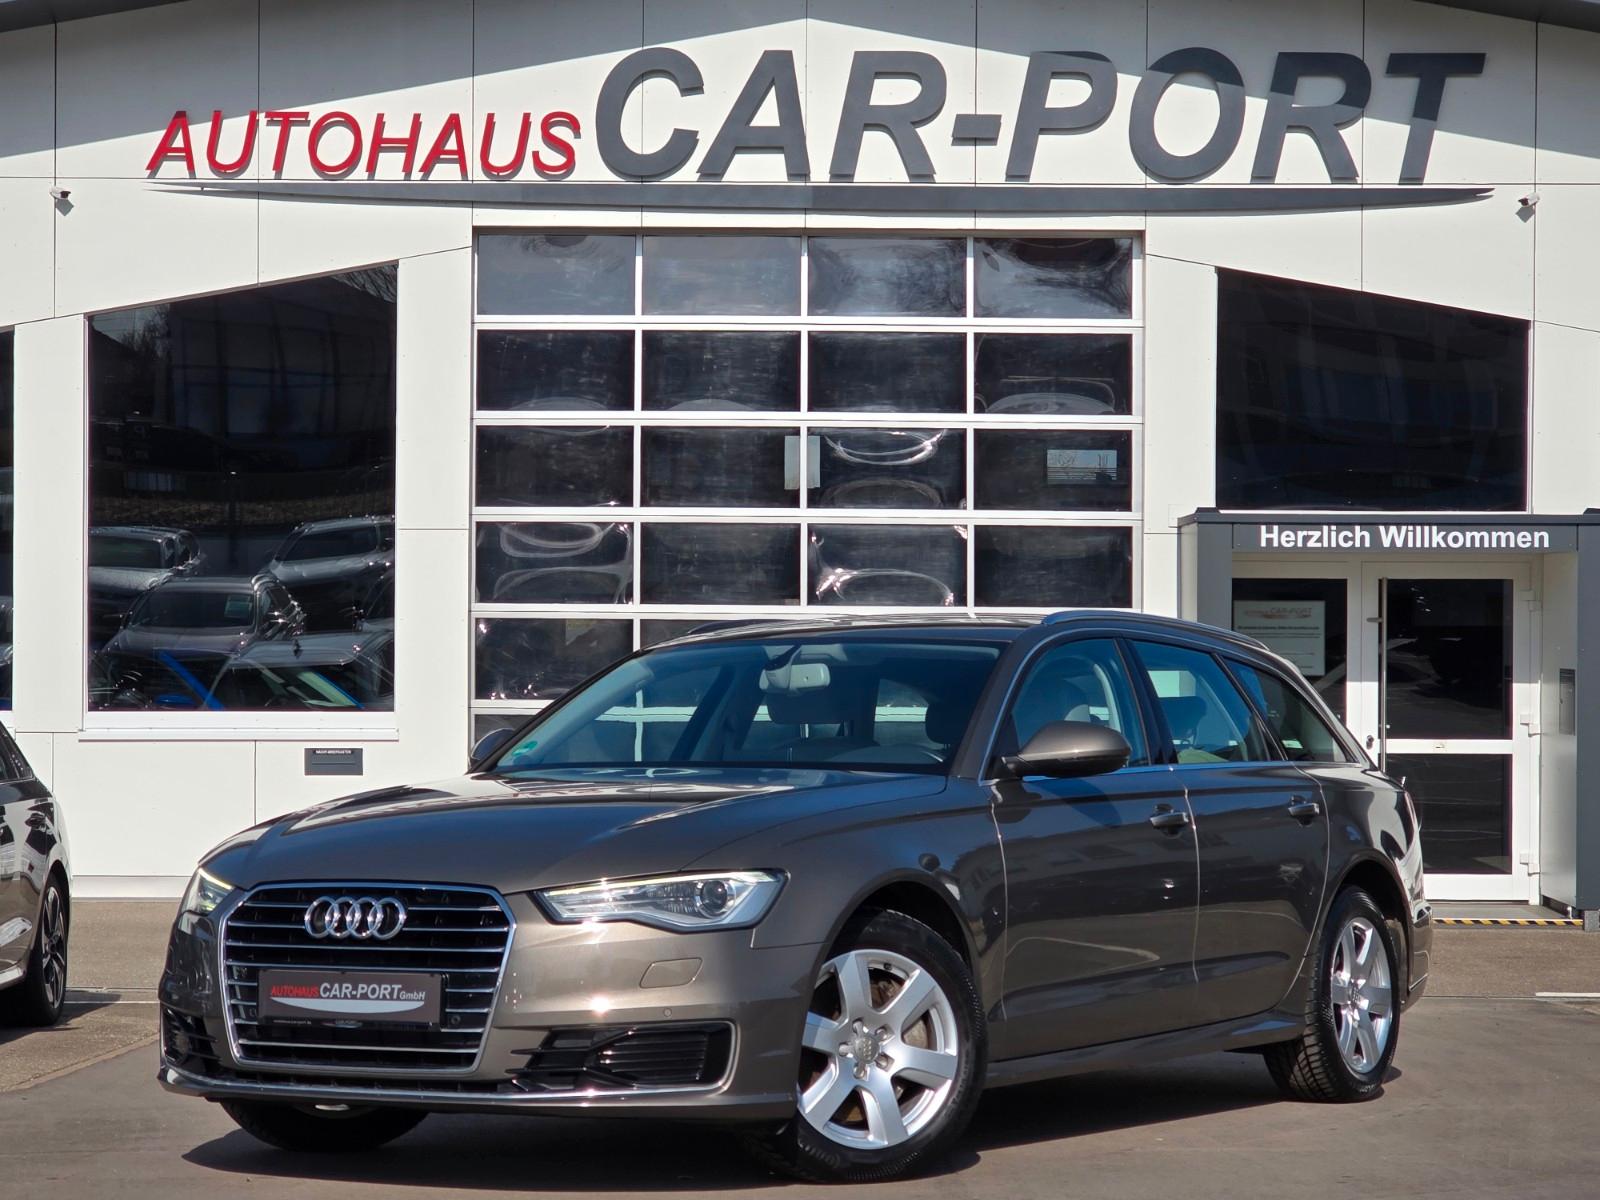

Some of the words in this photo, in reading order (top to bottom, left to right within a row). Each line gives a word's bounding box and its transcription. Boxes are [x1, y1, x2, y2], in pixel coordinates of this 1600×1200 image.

[146, 110, 581, 176] AUTOHAUS
[596, 47, 1487, 184] CAR-PORT
[1259, 525, 1371, 548] Herzlich
[1379, 525, 1550, 548] Willkommen
[270, 985, 320, 998] AUTOHAUS
[319, 982, 402, 1000] CAR-PORT
[400, 991, 426, 1001] GmbH
